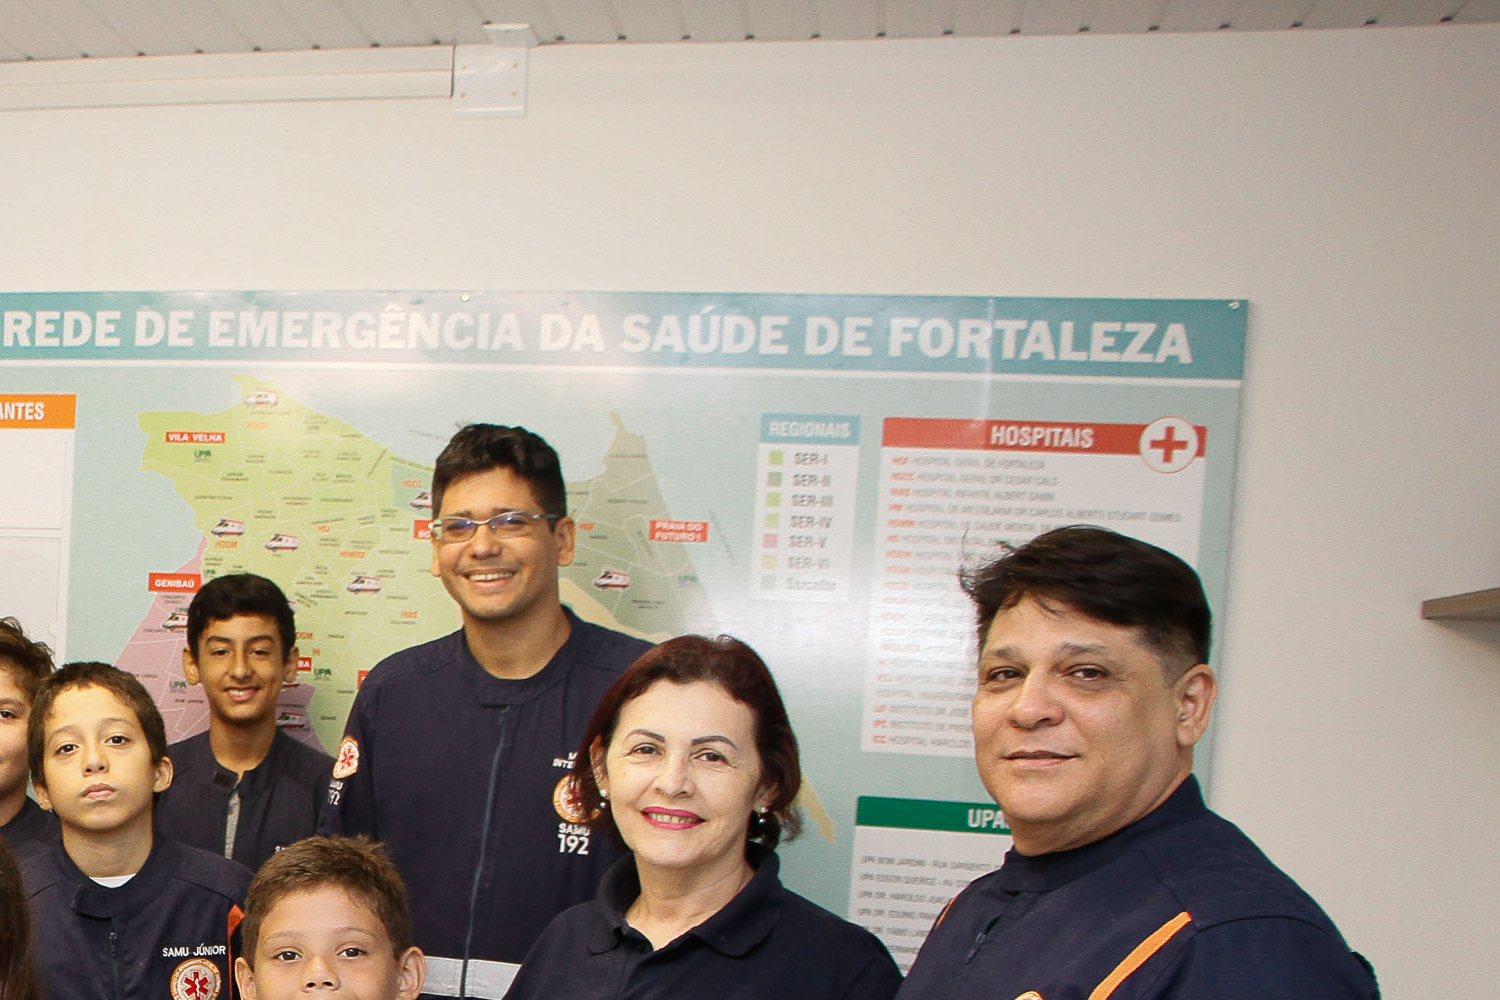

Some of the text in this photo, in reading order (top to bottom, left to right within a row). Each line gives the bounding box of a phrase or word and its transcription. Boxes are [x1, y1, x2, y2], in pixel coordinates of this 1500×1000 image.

[3, 304, 1194, 364] REDE DE EMERGÊNCIA DA SAÚDE DE FORTALEZA
[168, 433, 223, 442] VILA VELHA
[769, 421, 850, 438] REGIONAIS
[990, 425, 1095, 448] HOSPITAIS
[557, 833, 590, 855] 192
[162, 943, 226, 957] SAMU JÚNIOR
